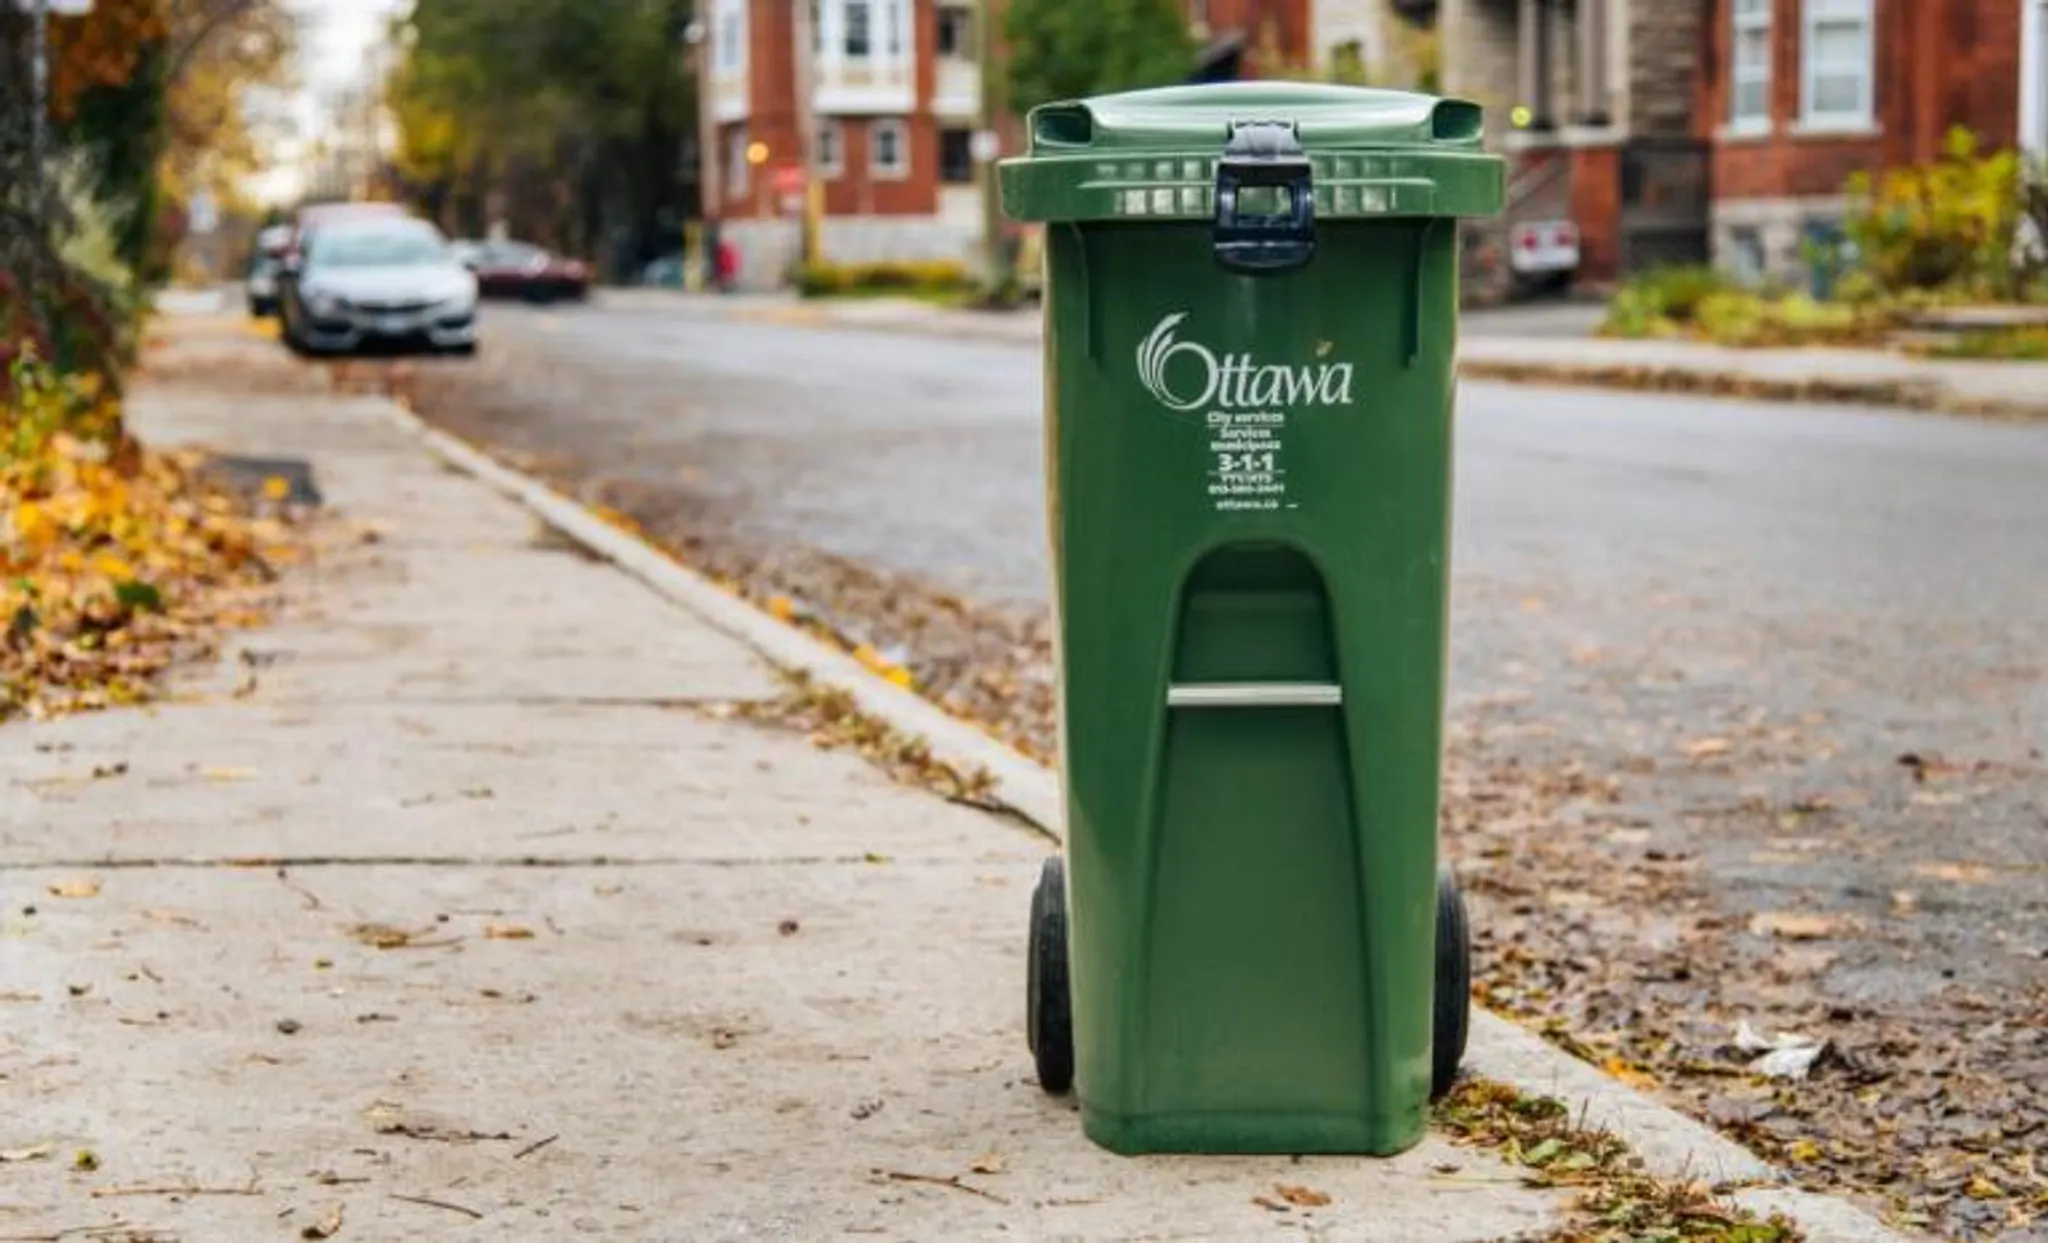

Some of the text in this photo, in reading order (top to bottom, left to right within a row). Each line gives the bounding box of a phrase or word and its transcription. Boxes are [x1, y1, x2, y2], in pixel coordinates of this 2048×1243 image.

[1136, 312, 1354, 410] Ottawa
[1207, 411, 1284, 428] City services
[1220, 427, 1271, 439] Services
[1218, 453, 1273, 471] 3-1-1
